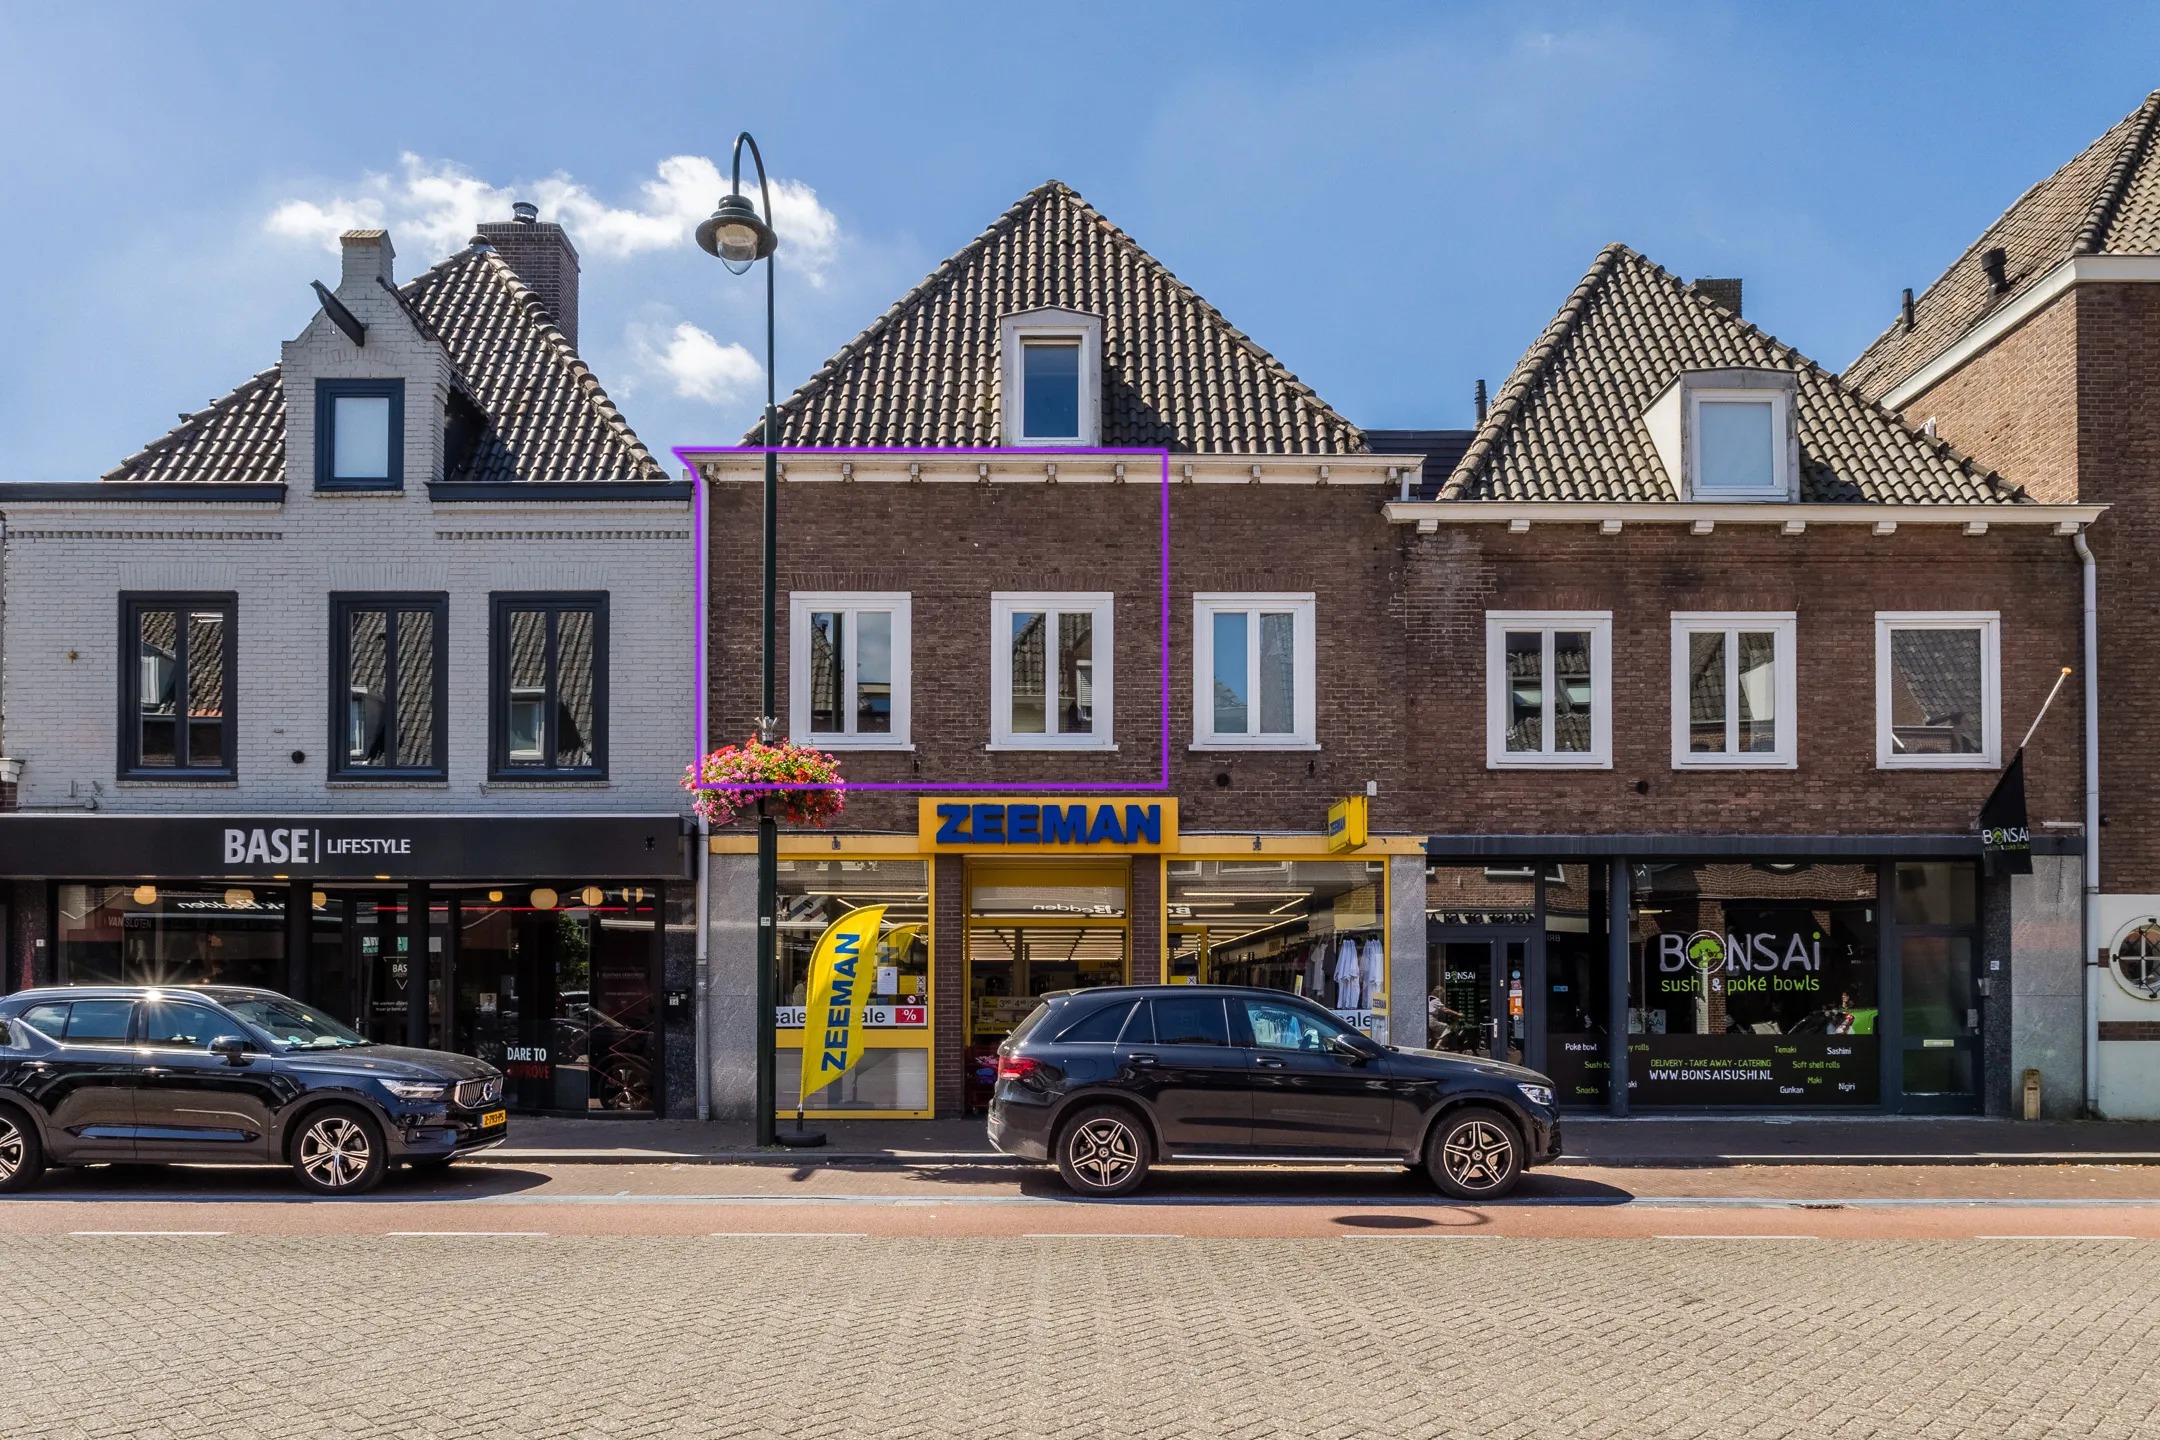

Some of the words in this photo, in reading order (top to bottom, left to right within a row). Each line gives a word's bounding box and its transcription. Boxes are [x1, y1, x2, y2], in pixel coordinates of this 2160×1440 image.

[936, 804, 1161, 844] ZEEMAN
[224, 828, 309, 864] BASE
[327, 838, 411, 854] LIFESTYLE
[392, 964, 408, 973] BAS
[1661, 975, 1701, 992] sush
[1711, 977, 1722, 992] &
[1727, 975, 1767, 995] poké
[1774, 974, 1820, 991] bowls
[821, 933, 860, 1071] ZEEMAN
[862, 1008, 886, 1023] ale
[1341, 1011, 1371, 1028] ale
[1582, 1042, 1597, 1051] bowl
[1634, 1043, 1650, 1051] rolls
[1774, 1045, 1797, 1053] Temaki
[1827, 1046, 1852, 1055] Sashimi
[507, 1047, 532, 1061] DARE
[533, 1047, 547, 1062] TO
[1584, 1060, 1603, 1069] Sushi
[1650, 1059, 1683, 1068] DELIVERY
[1690, 1059, 1708, 1068] TAKE
[1709, 1059, 1732, 1068] AWAY
[1738, 1059, 1772, 1068] CATERING
[1792, 1060, 1807, 1069] Soft
[1808, 1060, 1824, 1069] shell
[1825, 1060, 1841, 1069] rolls
[1649, 1069, 1774, 1081] WWW.BONSAISUSHI.NL
[1807, 1076, 1823, 1084] Maki
[1575, 1086, 1599, 1094] Snacks
[1779, 1085, 1804, 1094] Gunkan
[1838, 1082, 1856, 1092] Nigiri
